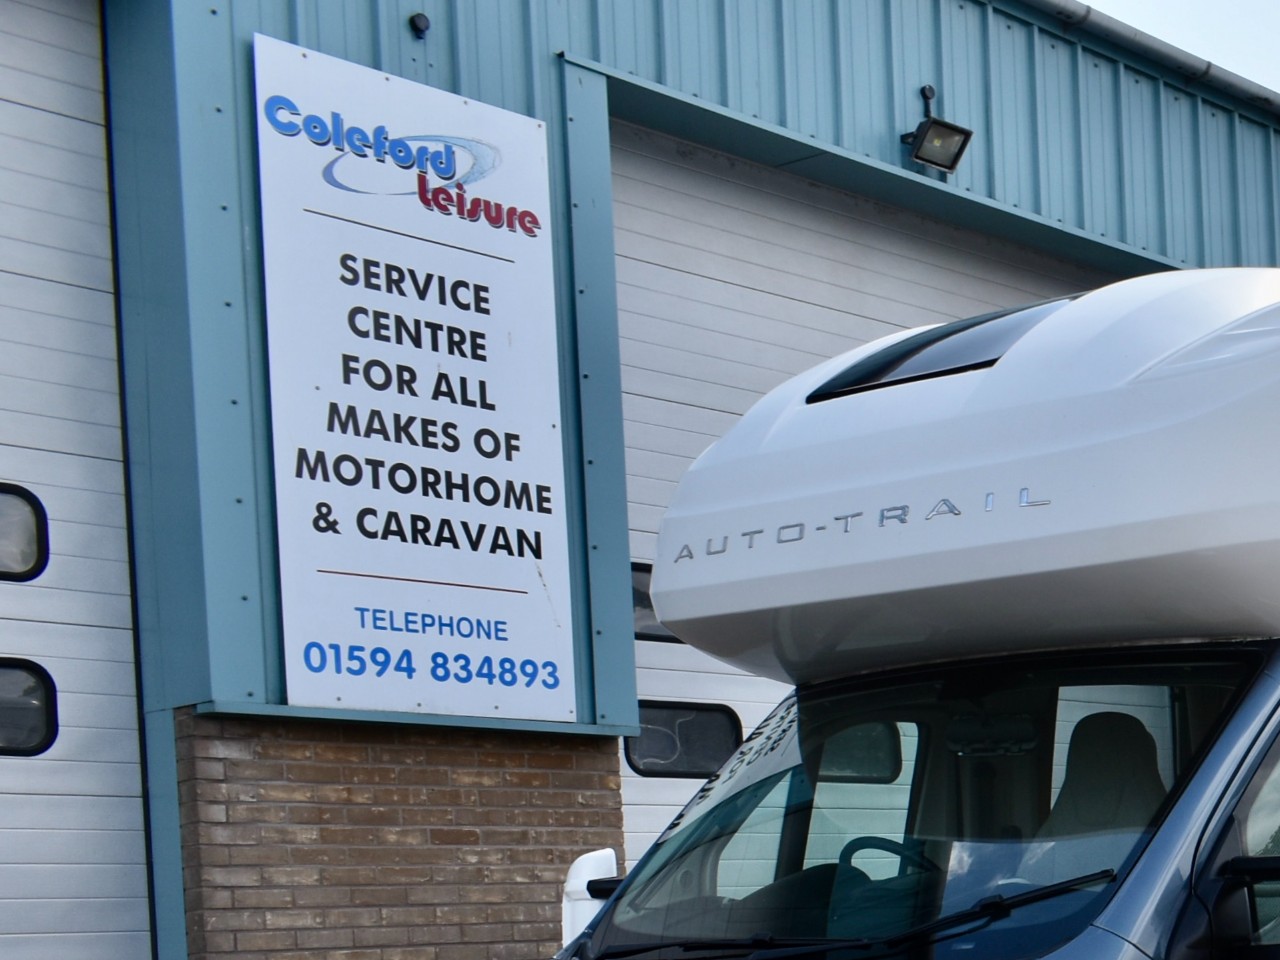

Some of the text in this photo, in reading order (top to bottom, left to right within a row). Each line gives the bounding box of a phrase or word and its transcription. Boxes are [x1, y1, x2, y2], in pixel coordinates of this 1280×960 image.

[264, 95, 456, 180] Coleford
[339, 253, 490, 315] SERVICE
[347, 306, 487, 362] CENTRE
[341, 353, 496, 411] FOR ALL
[327, 402, 520, 461] MAKES OF
[295, 447, 552, 514] MOTORHOME
[312, 502, 542, 560] & CARAVAN
[673, 487, 1051, 563] AUTO-TRAIL
[354, 607, 508, 641] TELEPHONE
[303, 641, 560, 690] 01594 834893
